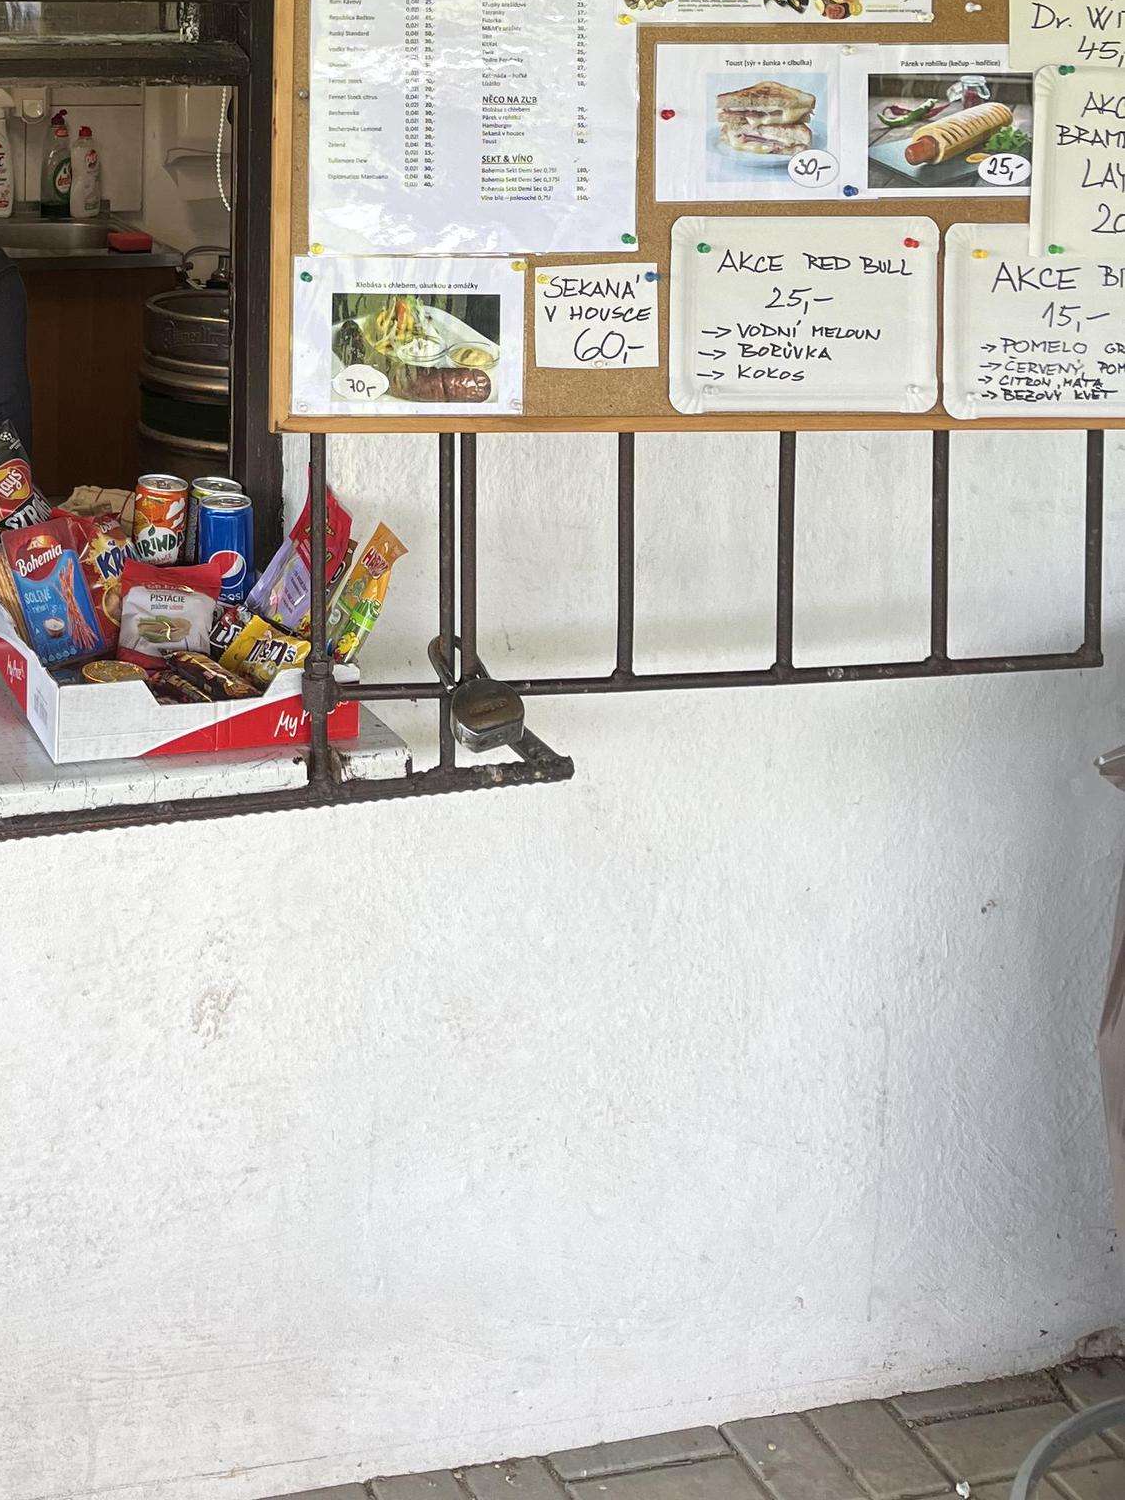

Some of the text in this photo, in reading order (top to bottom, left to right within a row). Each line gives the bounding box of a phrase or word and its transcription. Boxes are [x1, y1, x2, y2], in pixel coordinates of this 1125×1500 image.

[1031, 2, 1072, 30] Dr.
[482, 95, 505, 103] NĚCO
[1056, 124, 1125, 149] BRAM
[512, 154, 533, 162] VÍNO
[793, 157, 832, 181] 30,-
[987, 158, 1023, 182] 25,-
[717, 249, 912, 276] AKCE RED BULL
[543, 274, 641, 300] SEKANÁ
[991, 262, 1081, 292] AKCE
[765, 287, 834, 315] 25,-
[545, 305, 652, 323] V HOUSCE
[1042, 302, 1110, 332] 15,-
[737, 320, 881, 340] VODNÍ MELOUN
[574, 328, 645, 364] 60,-
[1000, 337, 1087, 354] POMELO
[737, 364, 805, 382] KOKOS
[1005, 356, 1085, 375] ČERVENÝ
[346, 378, 377, 398] 70,-
[16, 544, 63, 577] Bohemia
[150, 594, 185, 602] PISTACIE
